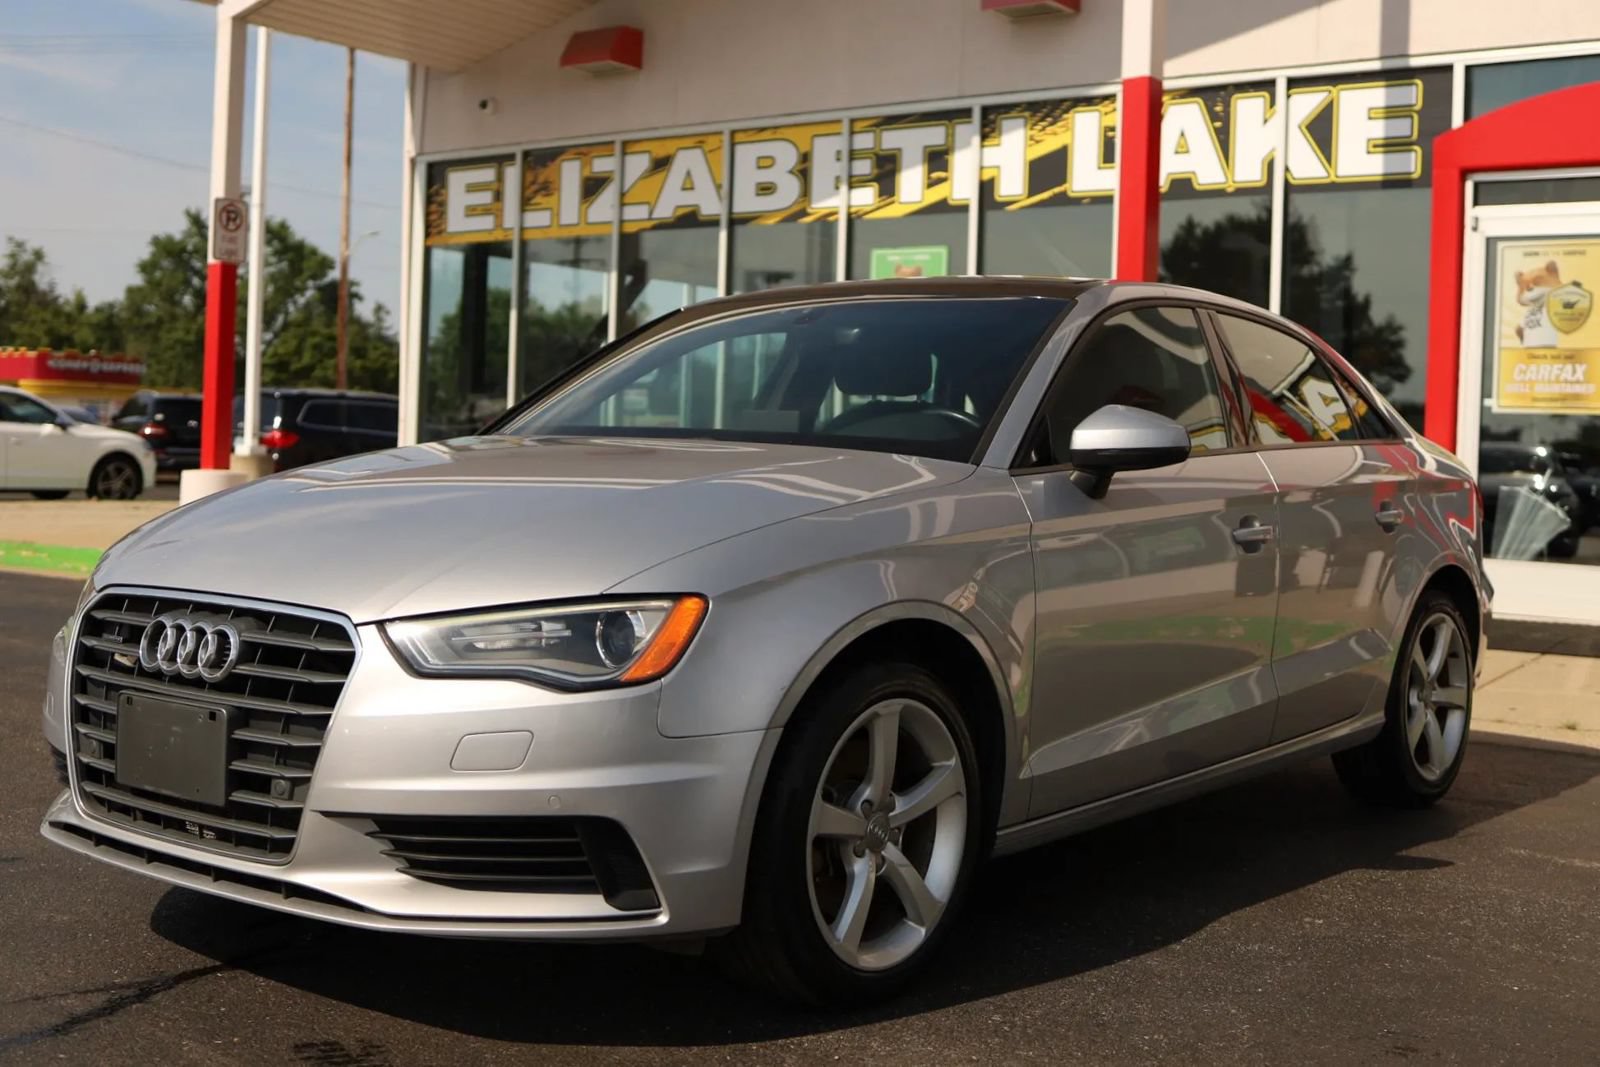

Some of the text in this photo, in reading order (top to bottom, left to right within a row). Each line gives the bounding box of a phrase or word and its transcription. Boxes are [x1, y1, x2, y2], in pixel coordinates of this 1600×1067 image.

[445, 79, 1422, 233] ELIZABETH LAKE
[1513, 362, 1588, 382] CARFAX
